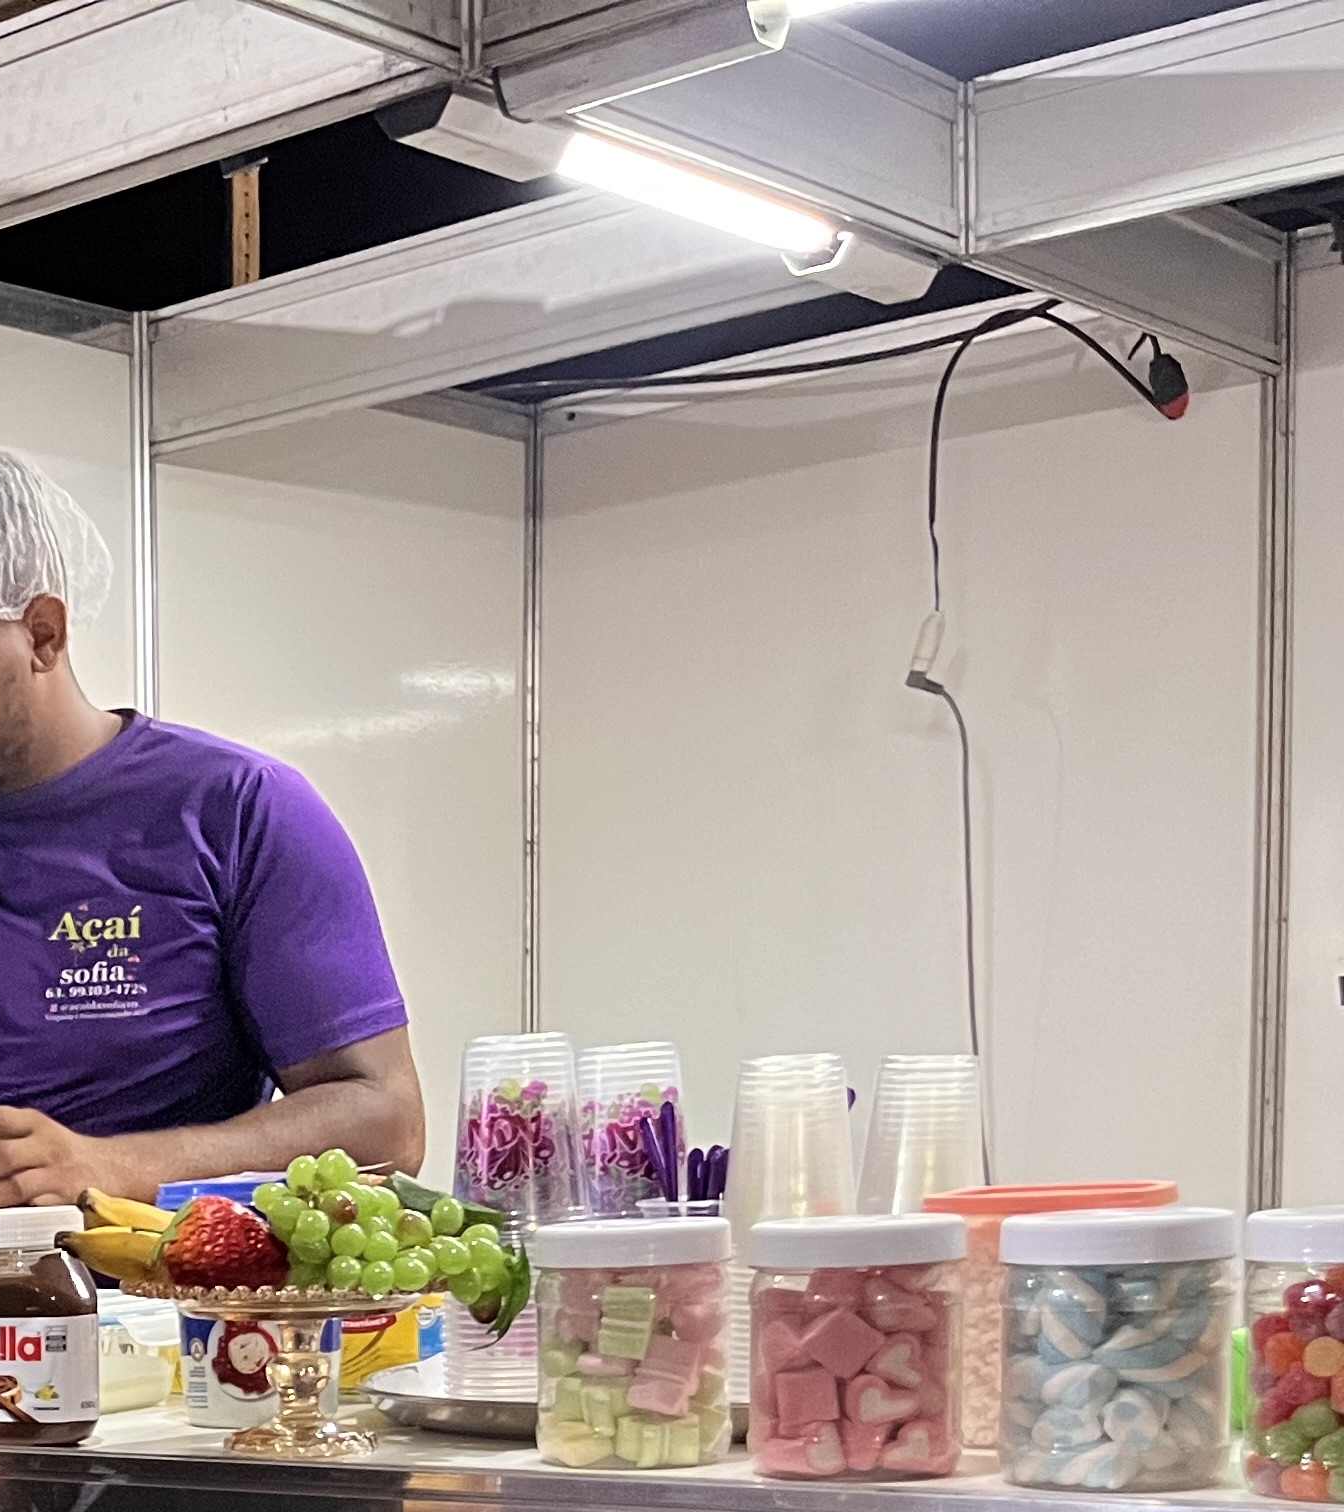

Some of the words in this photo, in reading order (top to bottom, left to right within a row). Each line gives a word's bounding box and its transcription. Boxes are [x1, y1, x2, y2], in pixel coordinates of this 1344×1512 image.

[47, 904, 143, 947] Açaí
[106, 943, 130, 958] da
[59, 961, 126, 985] sofia
